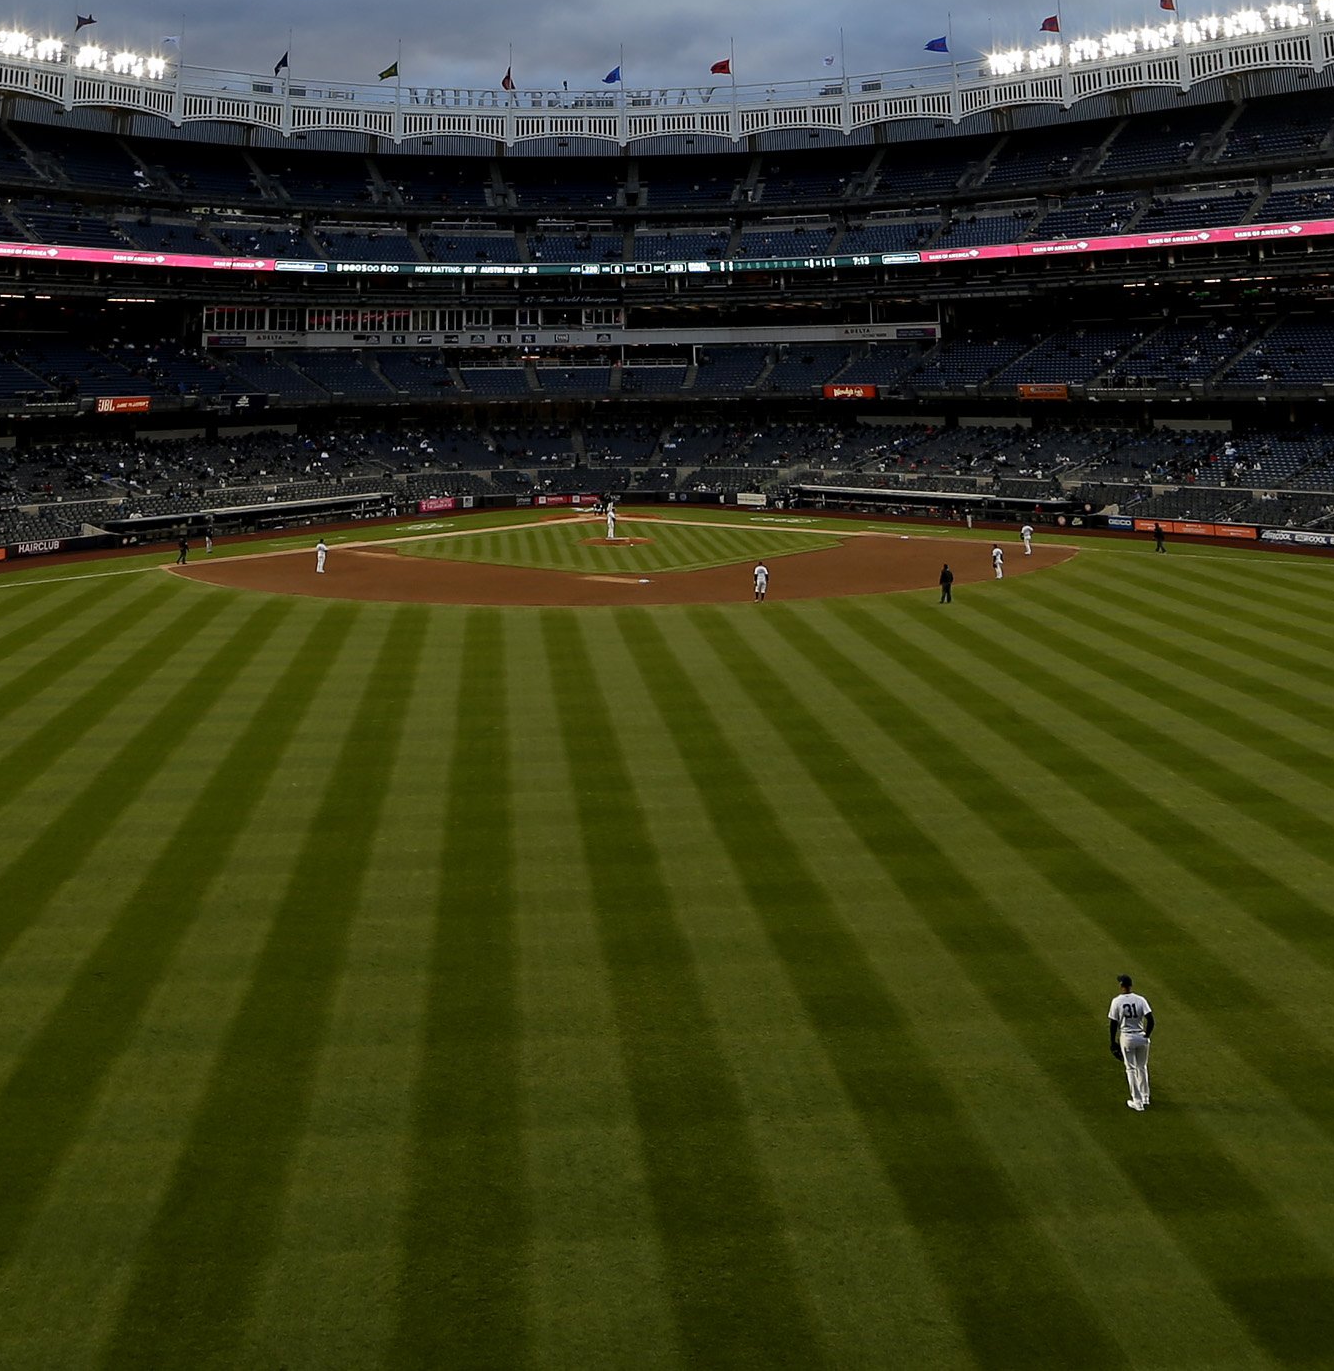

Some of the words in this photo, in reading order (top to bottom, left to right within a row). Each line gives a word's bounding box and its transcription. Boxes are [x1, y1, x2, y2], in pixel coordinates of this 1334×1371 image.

[853, 257, 869, 265] 7:13
[98, 399, 115, 412] JBL
[1108, 518, 1132, 526] GEICO
[1309, 535, 1327, 545] COOL
[18, 540, 60, 554] HAIRCLUB
[1123, 1003, 1138, 1019] 31
